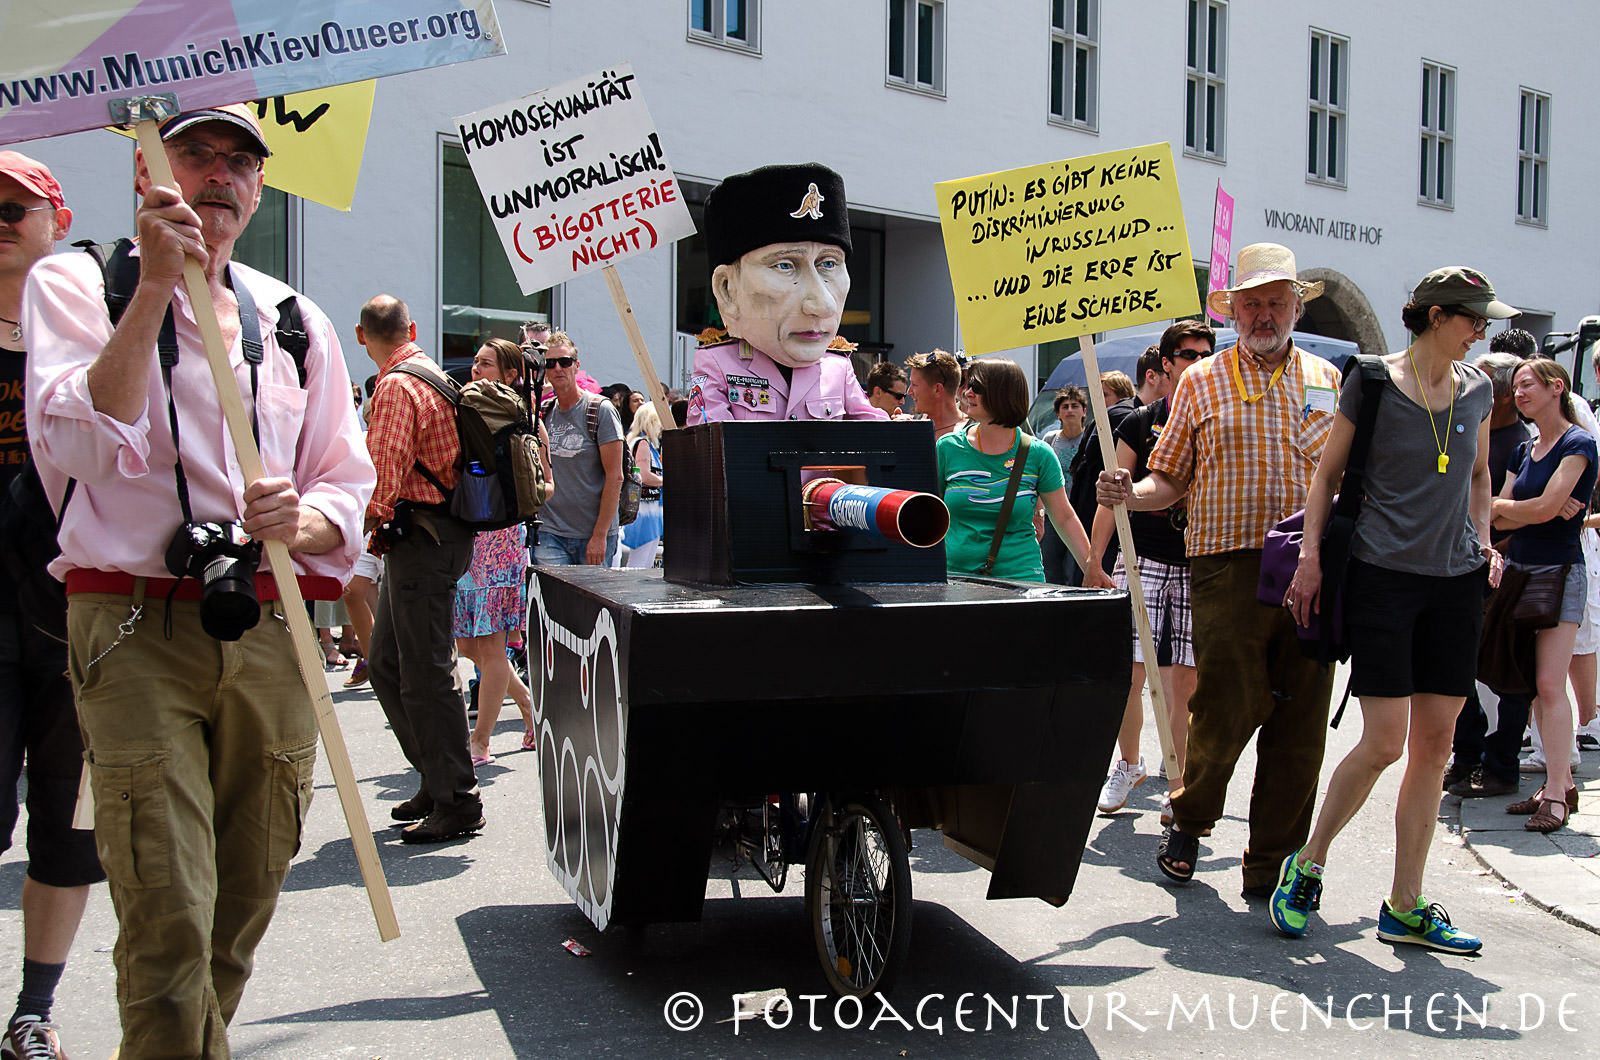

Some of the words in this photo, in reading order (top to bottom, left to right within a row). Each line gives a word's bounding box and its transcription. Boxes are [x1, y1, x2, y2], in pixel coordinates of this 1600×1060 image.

[490, 132, 666, 219] UNMORALISCH!
[951, 182, 1015, 219] PUTIN:
[1023, 177, 1046, 202] ES
[1052, 164, 1096, 195] GIBT
[1100, 155, 1161, 188] KEINE
[971, 194, 1125, 244] DISKRIMINIERUNG
[1264, 208, 1325, 236] VINORANT
[1327, 219, 1356, 242] ALTER
[1359, 224, 1383, 245] HOF
[1042, 264, 1073, 288] DIE
[1084, 256, 1138, 283] ERDE
[1147, 249, 1182, 272] IST
[1023, 300, 1067, 330] EINE
[1071, 288, 1162, 320] SCHEIBE.
